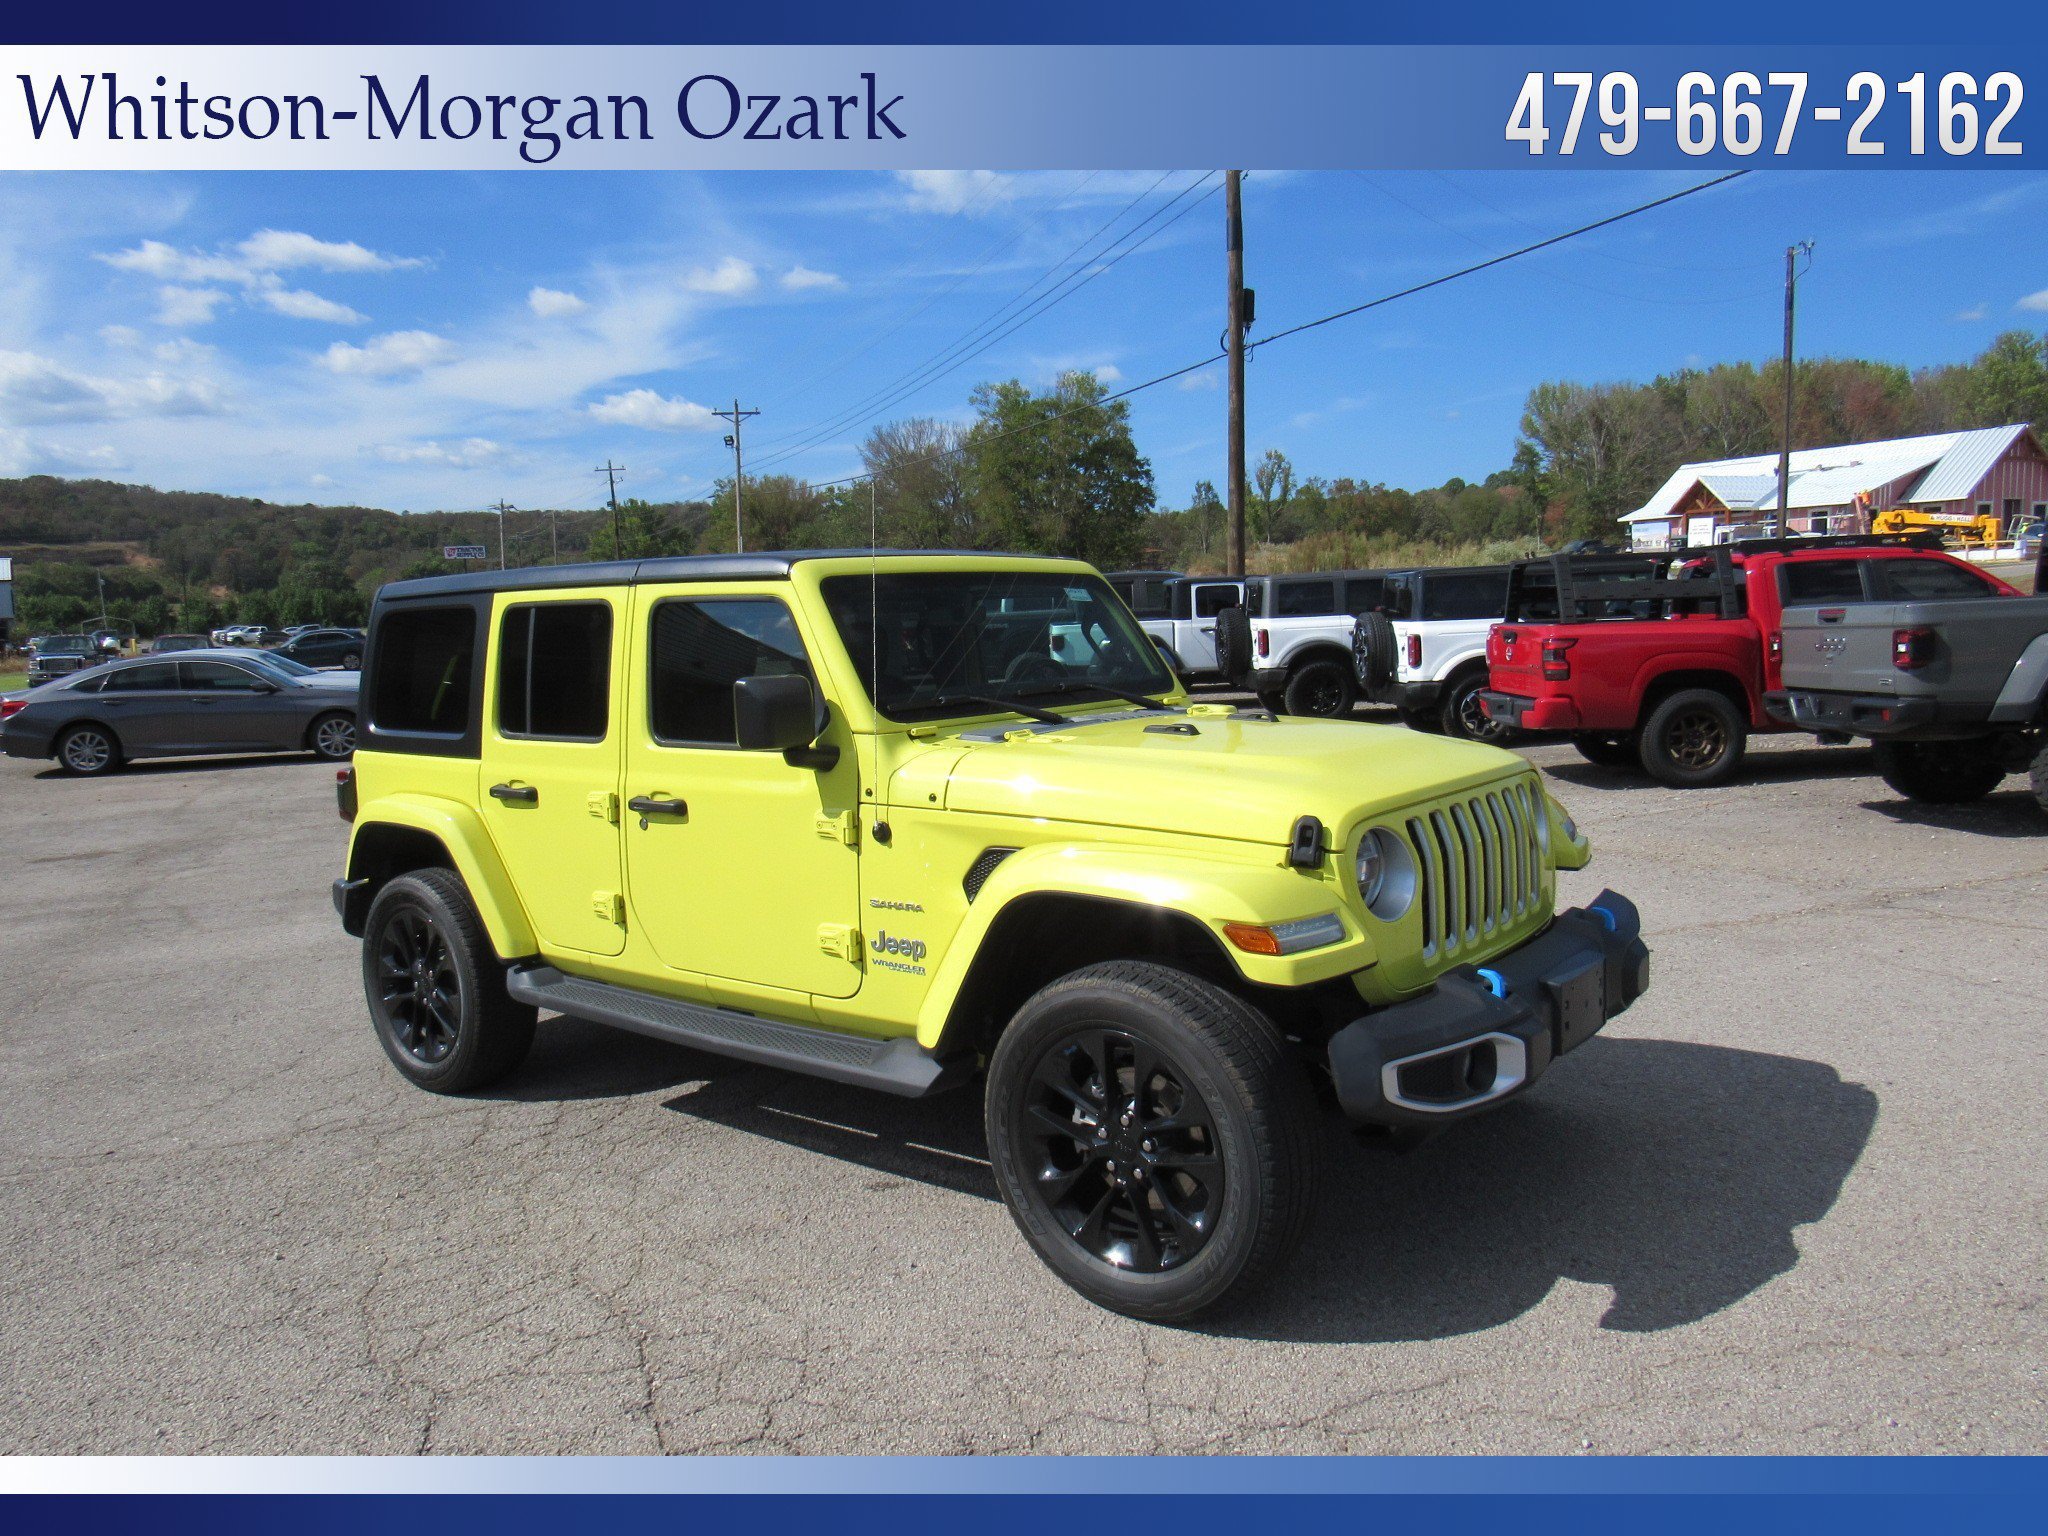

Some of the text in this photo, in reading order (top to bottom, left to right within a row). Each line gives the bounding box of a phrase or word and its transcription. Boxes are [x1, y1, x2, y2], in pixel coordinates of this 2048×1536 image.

[870, 899, 925, 913] SAHARA
[870, 929, 926, 962] Jeep
[872, 958, 925, 973] WRANGLER
